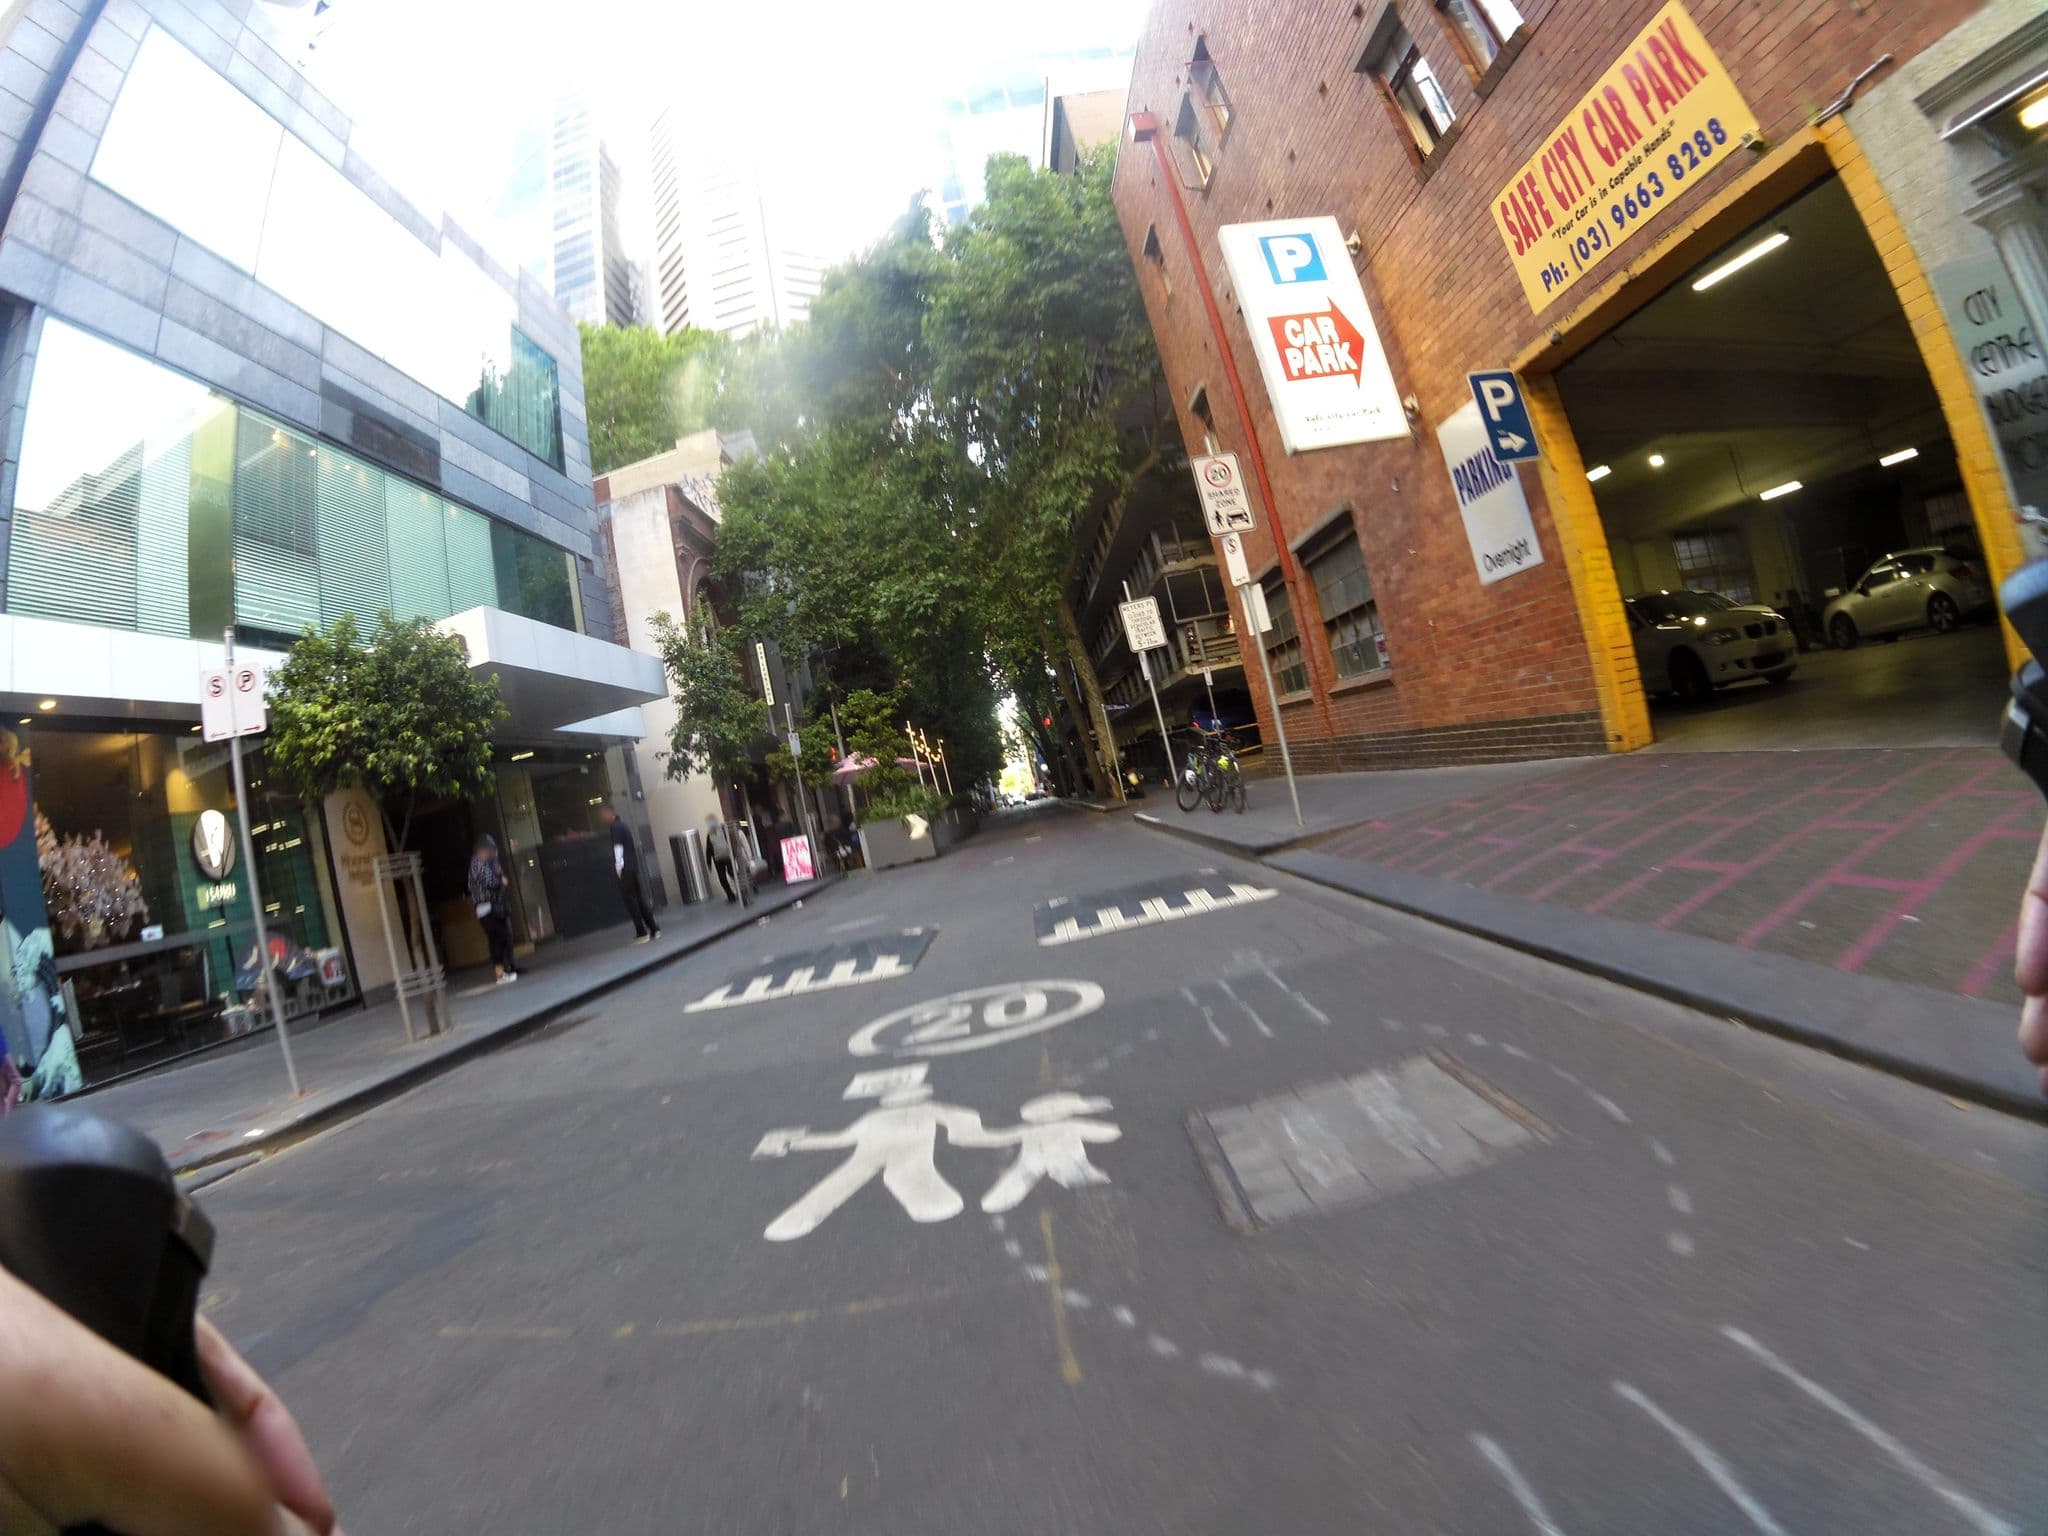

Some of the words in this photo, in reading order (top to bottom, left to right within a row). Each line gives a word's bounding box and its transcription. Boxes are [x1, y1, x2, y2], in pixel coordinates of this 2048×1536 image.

[1500, 171, 1554, 256] SAFE
[1541, 125, 1595, 211] CITY
[1583, 85, 1643, 167] CAR
[1621, 15, 1709, 126] PARK
[1552, 219, 1574, 240] "Your
[1575, 204, 1589, 221] Car
[1590, 197, 1597, 209] is
[1598, 188, 1608, 198] in
[1608, 154, 1642, 189] Capable
[1642, 119, 1675, 158] Hands"
[1541, 262, 1568, 293] Ph:
[1570, 218, 1611, 272] (03)
[1611, 172, 1664, 230] 9663
[1666, 118, 1727, 180] 8288
[1268, 237, 1312, 282] P
[1963, 284, 2002, 326] CITY
[1284, 316, 1340, 347] CAR
[1971, 326, 2038, 377] CENTRE
[1285, 342, 1358, 376] PARK
[1479, 379, 1515, 422] P
[1207, 488, 1241, 500] SHARED
[1215, 499, 1237, 509] ZONE
[1484, 537, 1532, 572] Overnight
[901, 990, 1048, 1046] 20
